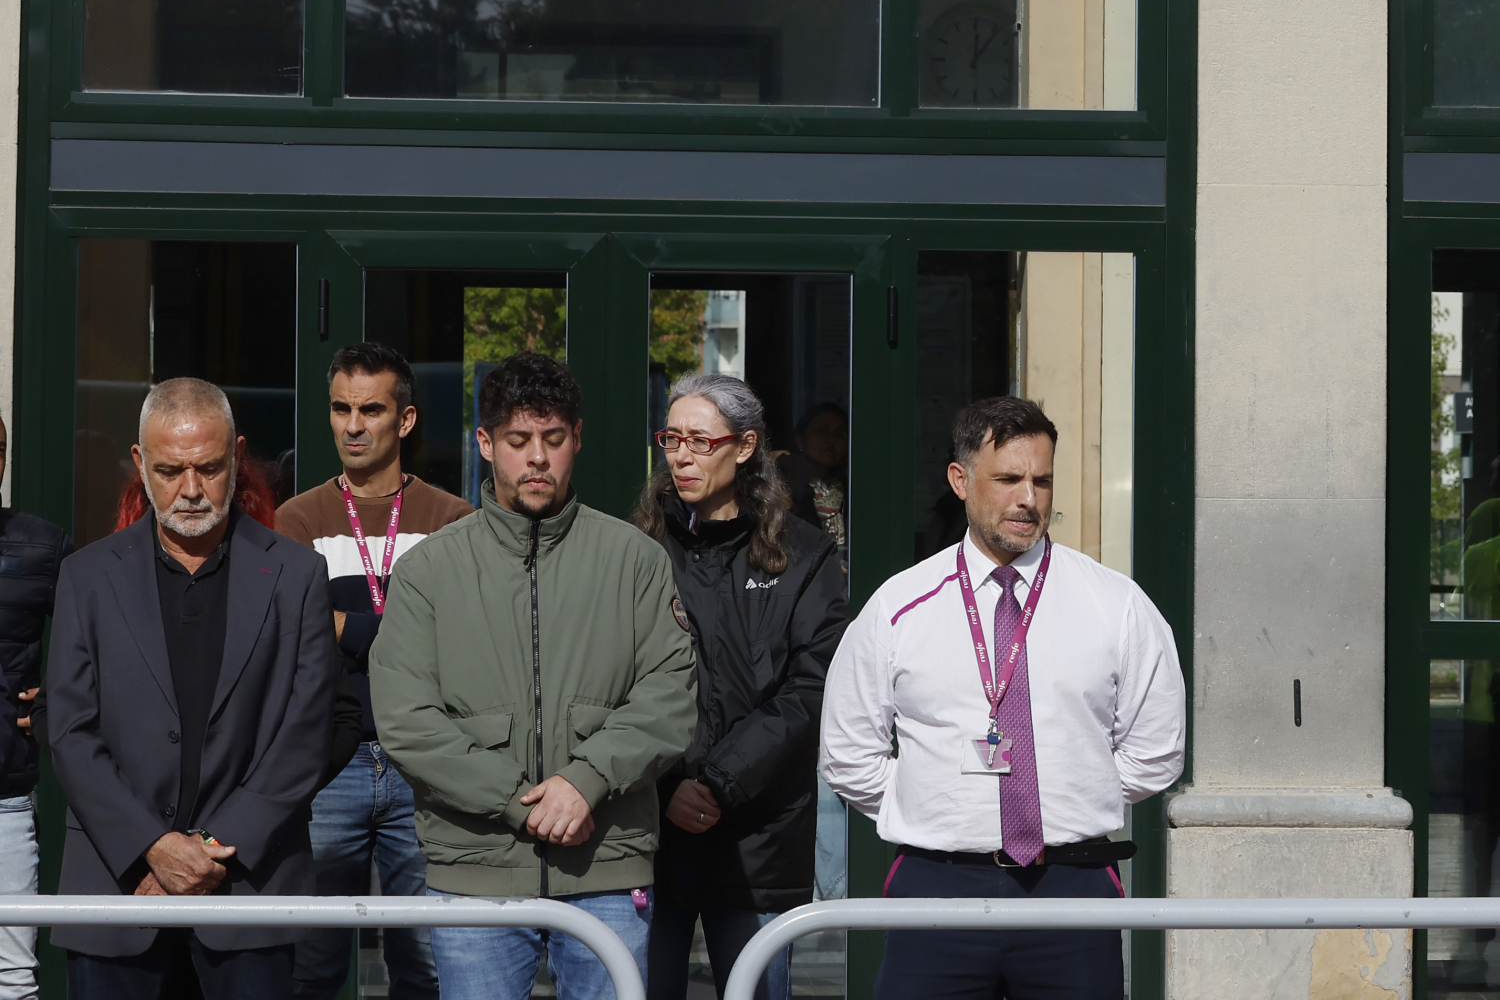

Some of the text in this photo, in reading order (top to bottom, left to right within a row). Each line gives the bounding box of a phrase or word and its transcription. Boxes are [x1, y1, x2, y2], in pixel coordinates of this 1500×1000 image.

[347, 500, 357, 518] renfe
[355, 527, 365, 546] renfe
[386, 536, 394, 556] renfe
[364, 556, 374, 576] renfe
[960, 570, 969, 589] renfe
[1034, 572, 1044, 592] renfe
[372, 586, 381, 606] renfe
[968, 605, 978, 625] renfe
[1022, 606, 1031, 626] renfe
[976, 642, 986, 662] renfe
[1009, 642, 1019, 663] renfe
[996, 680, 1006, 700] renfe
